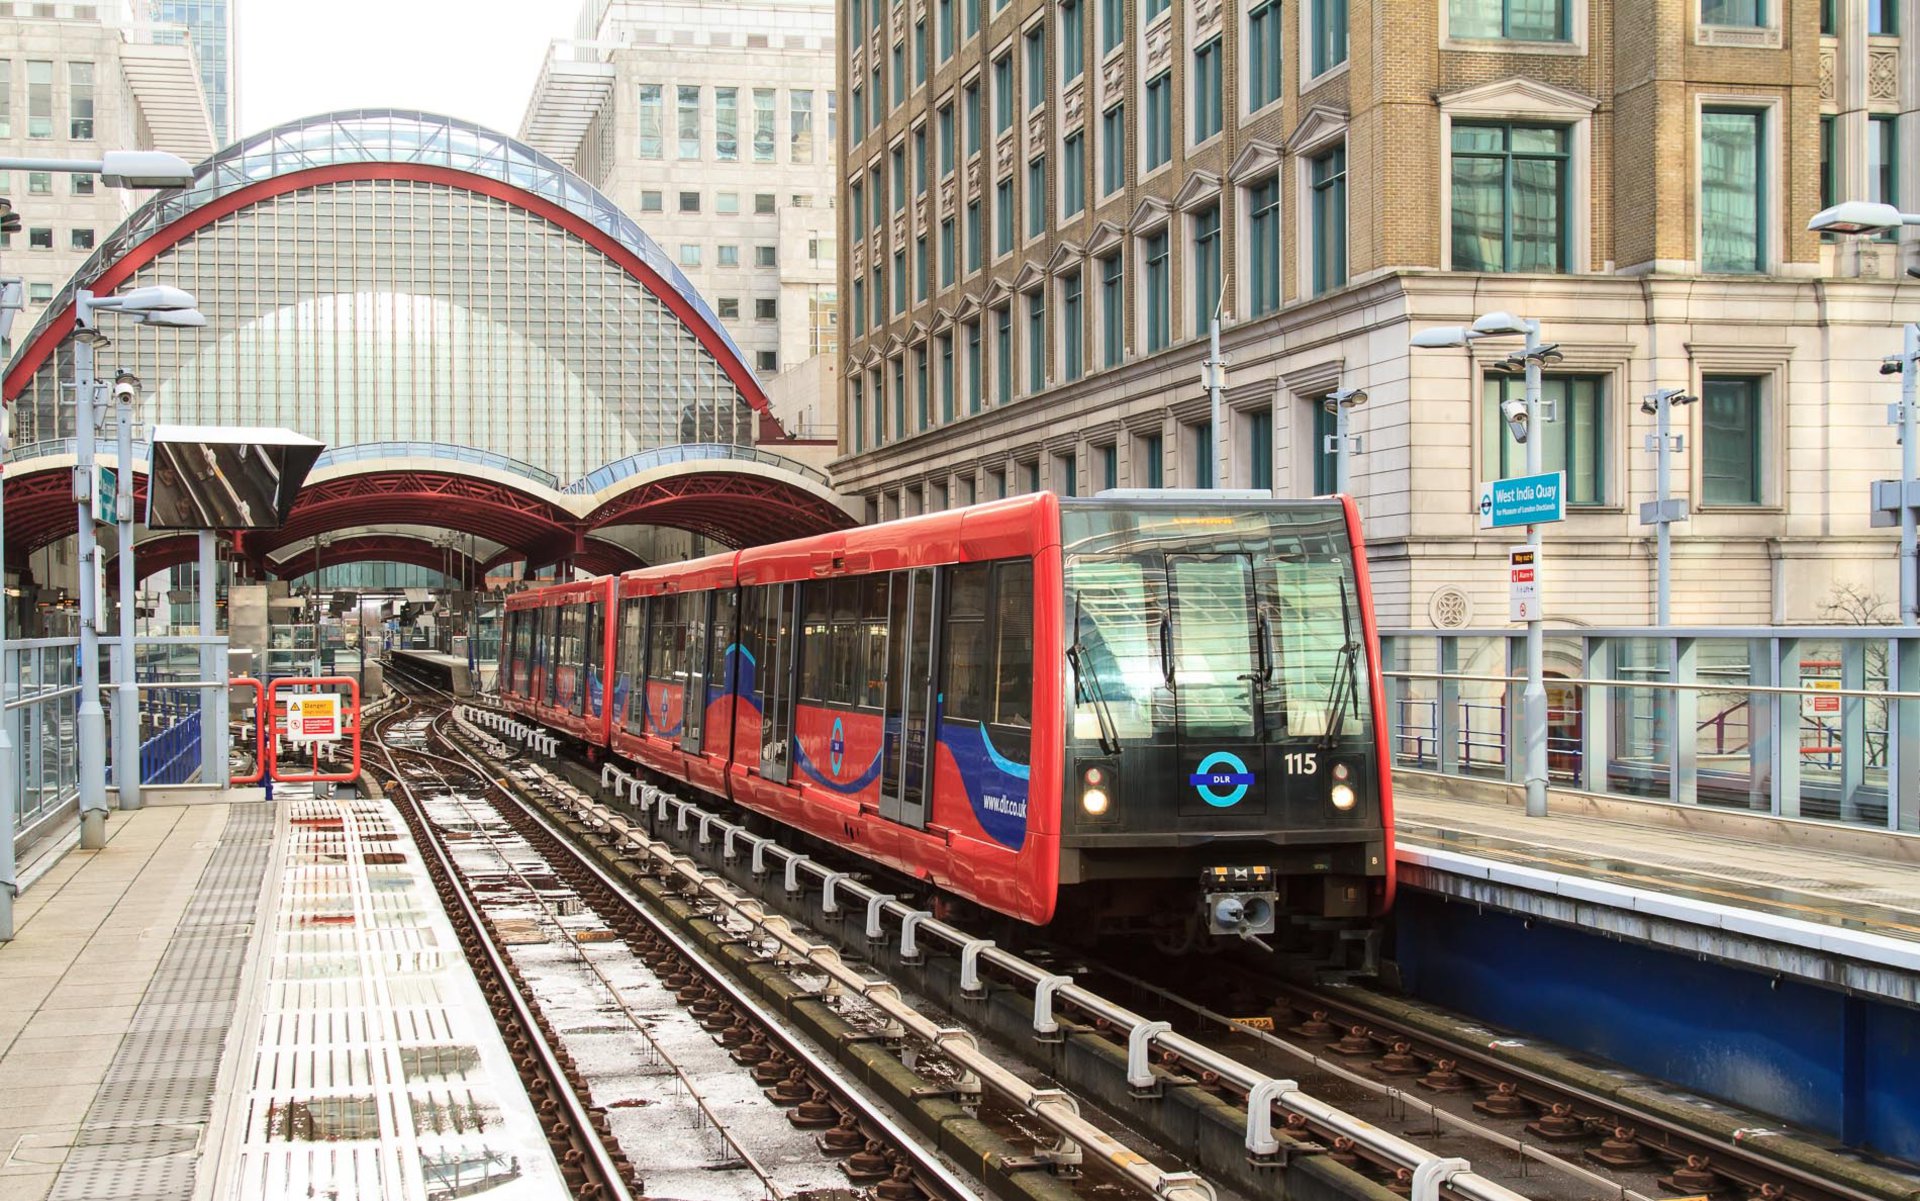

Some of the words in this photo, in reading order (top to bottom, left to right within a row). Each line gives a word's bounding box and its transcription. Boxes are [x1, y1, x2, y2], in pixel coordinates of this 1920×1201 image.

[1496, 489, 1515, 503] West
[1517, 486, 1534, 501] India
[1536, 484, 1556, 500] Quay
[1522, 505, 1535, 513] London
[1536, 503, 1556, 512] Docklands
[1284, 752, 1317, 775] 115
[1213, 775, 1231, 783] DLR
[983, 794, 1027, 819] www.dlr.co.uk
